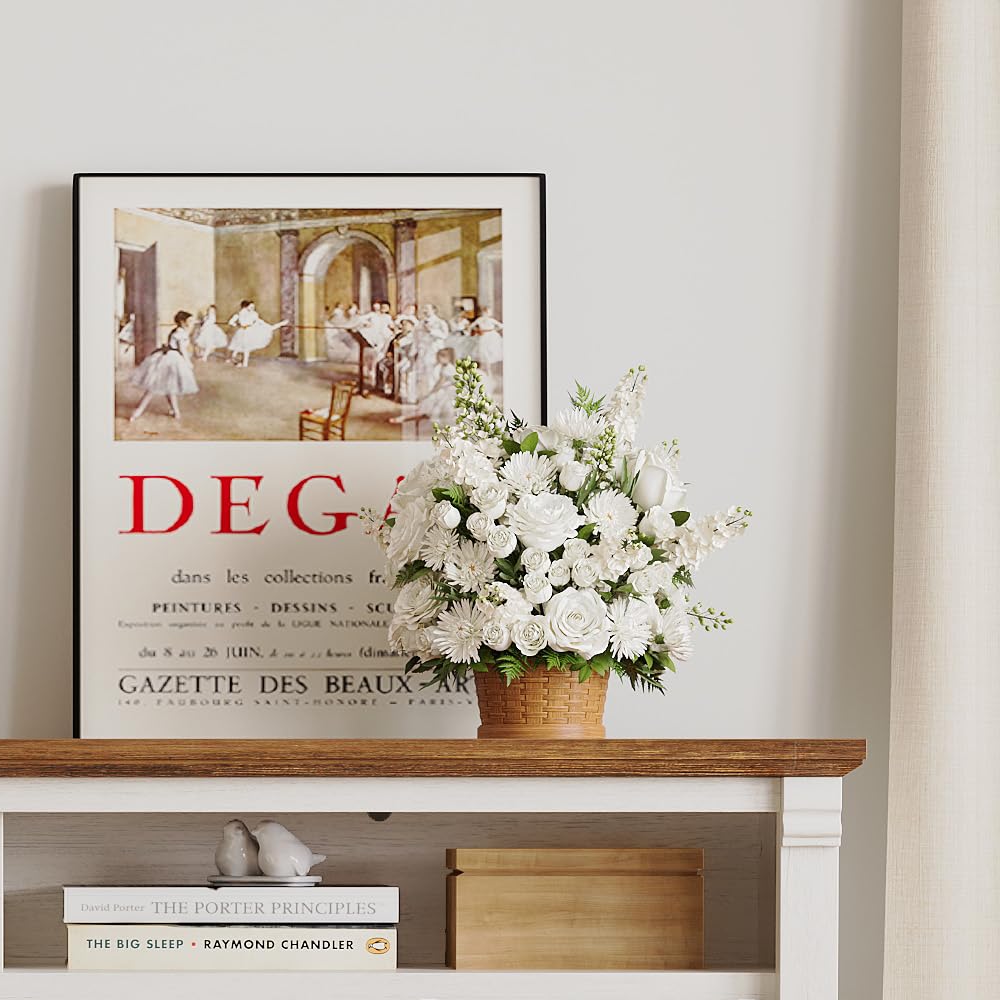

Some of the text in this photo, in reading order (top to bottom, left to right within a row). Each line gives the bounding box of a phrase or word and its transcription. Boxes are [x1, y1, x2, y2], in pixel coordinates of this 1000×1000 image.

[171, 569, 386, 584] dans les collections fr
[152, 602, 242, 613] PEINTURES
[271, 602, 338, 613] DESSINS
[118, 674, 474, 694] GAZETTE DES BEAUX AR
[81, 901, 377, 915] David Porter THE PORTER PRINCIPLES
[87, 939, 354, 950] THE BIG SLEEP RAYMOND CHANDLER
